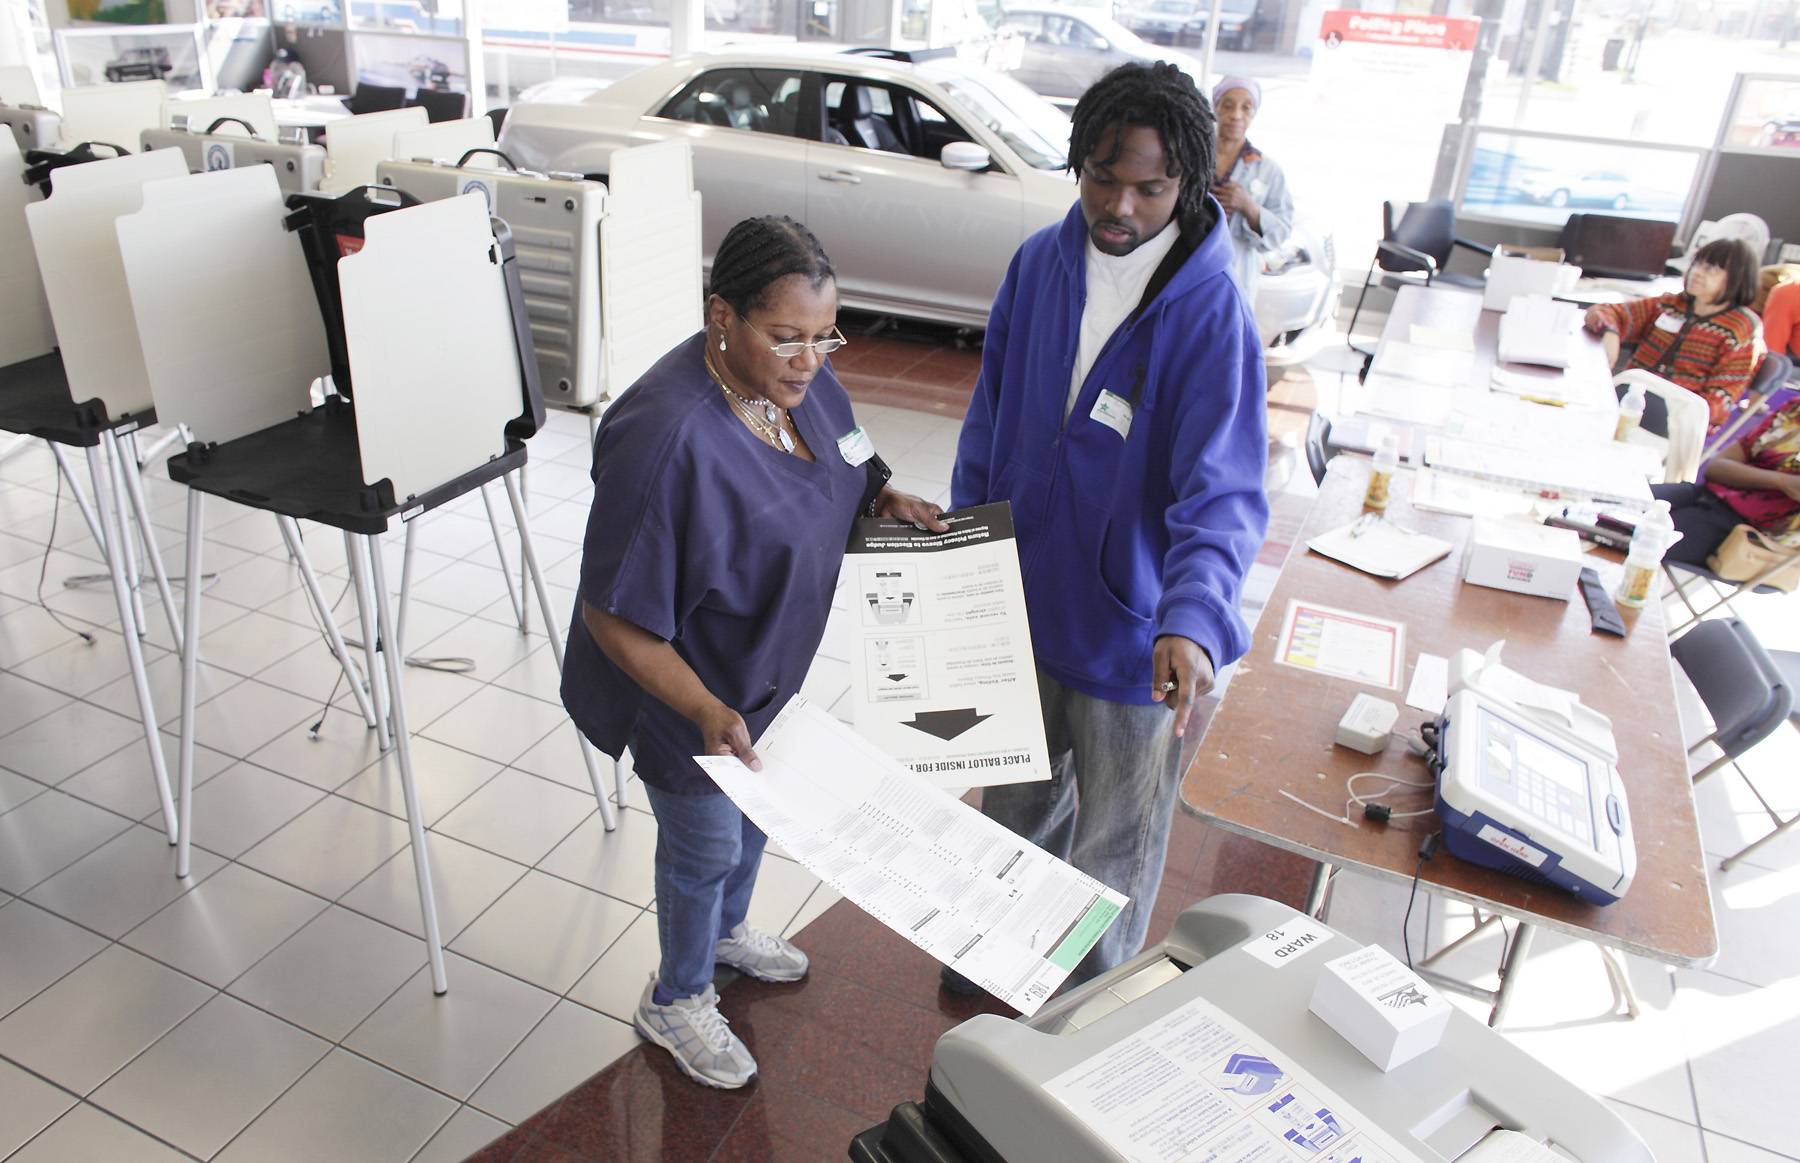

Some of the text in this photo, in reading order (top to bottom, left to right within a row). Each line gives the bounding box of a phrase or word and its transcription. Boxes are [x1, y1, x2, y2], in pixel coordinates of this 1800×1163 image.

[968, 757, 1001, 769] BALLOT
[1003, 754, 1031, 765] PLACE
[915, 763, 933, 773] FOR
[935, 760, 966, 772] INSIDE
[1265, 930, 1285, 941] 18
[1274, 933, 1318, 958] WARD
[1029, 980, 1050, 999] 189
